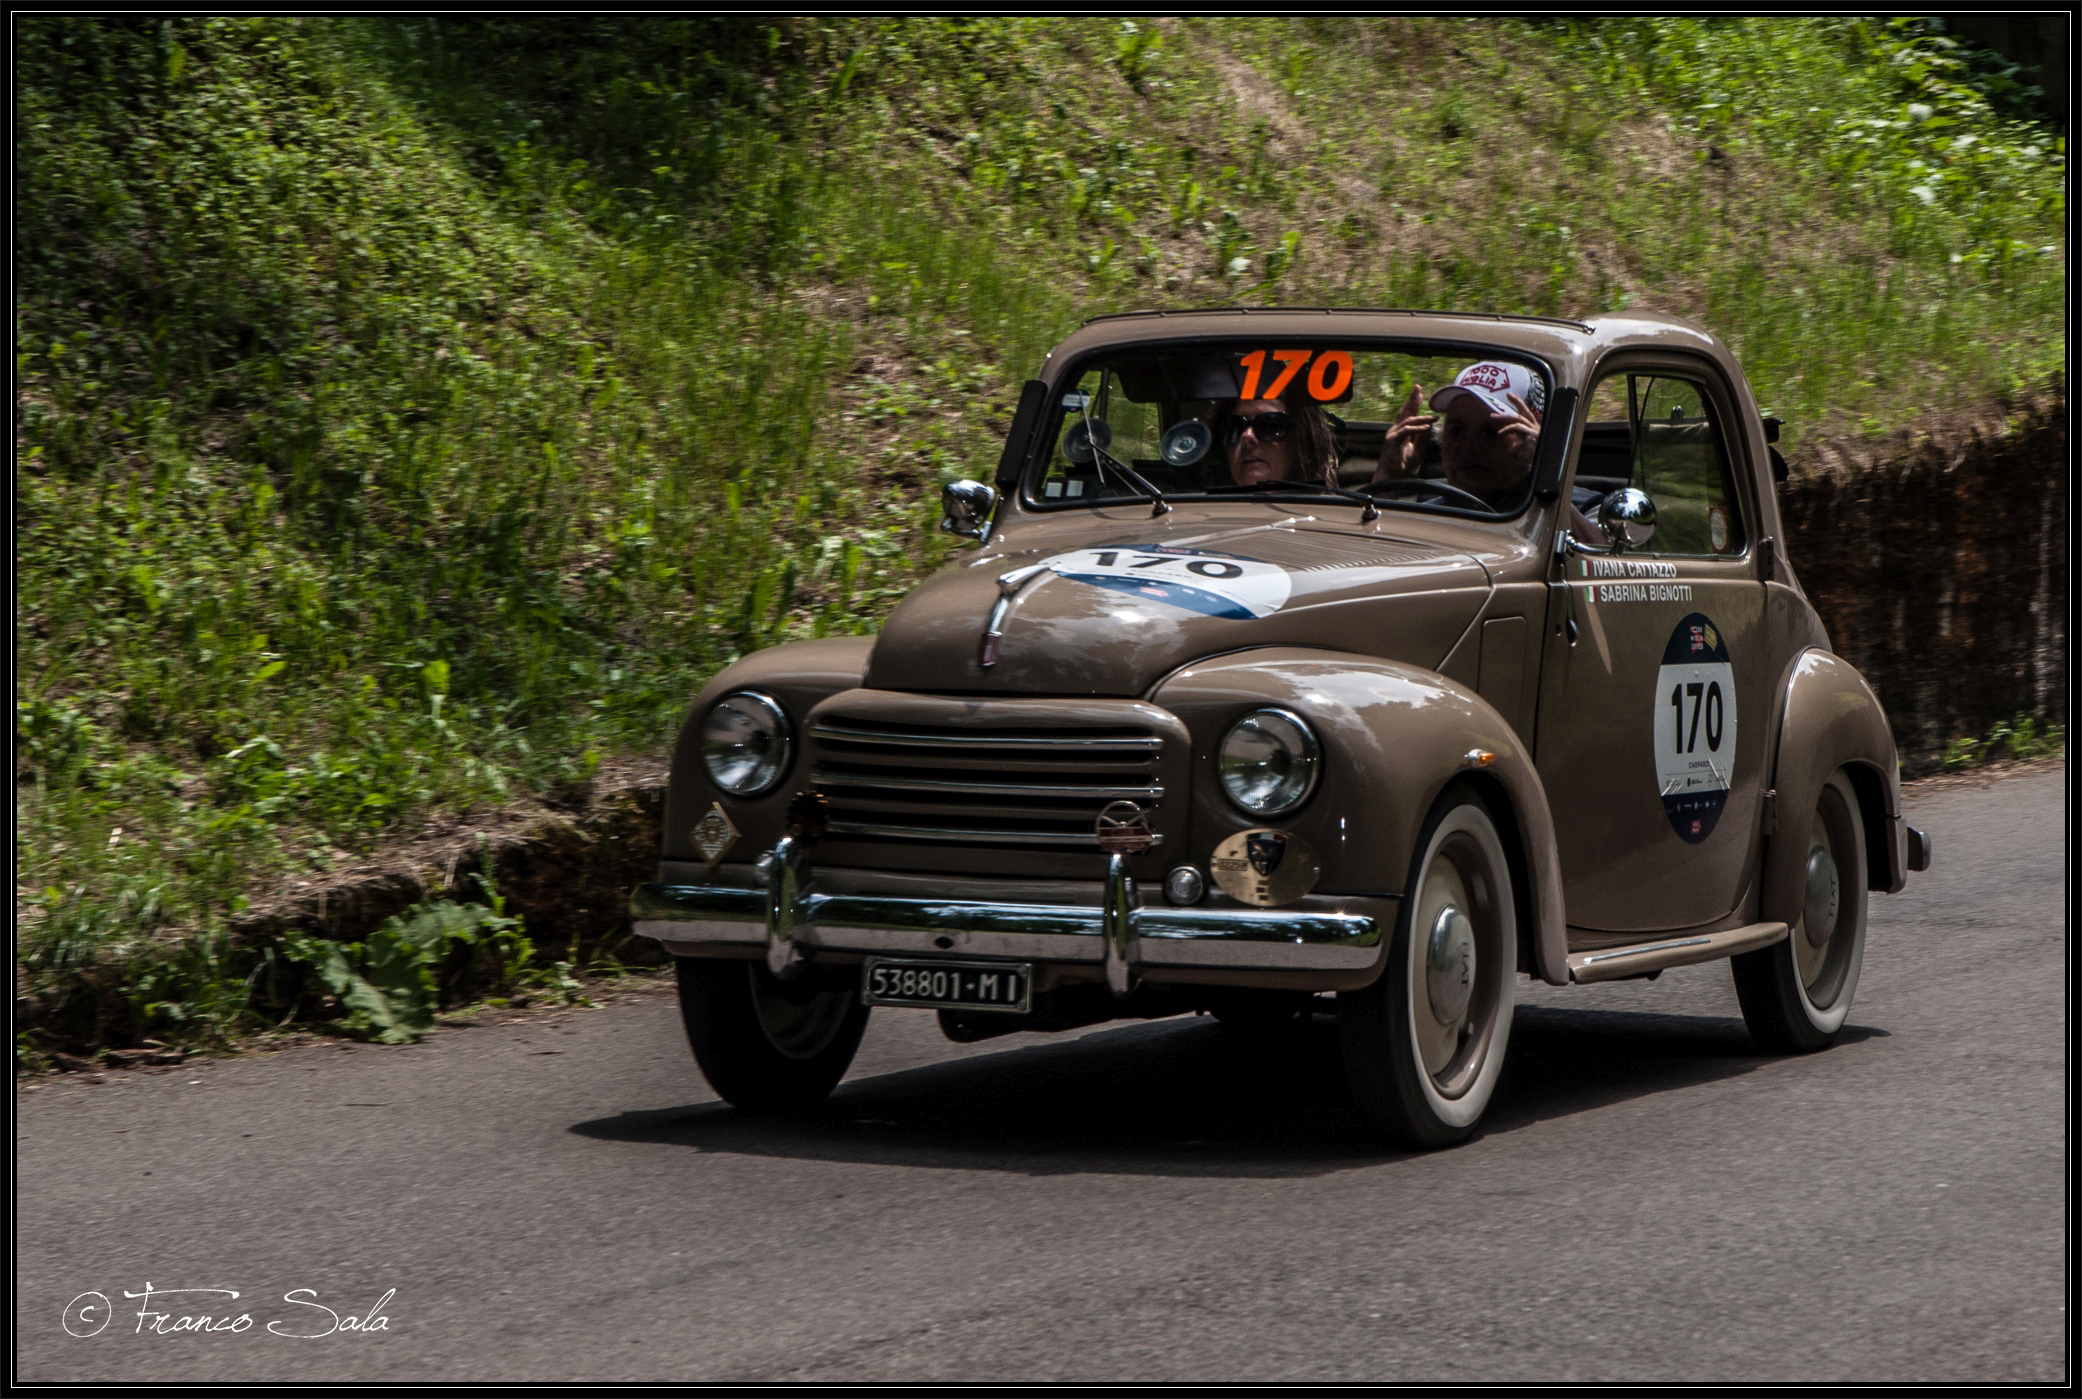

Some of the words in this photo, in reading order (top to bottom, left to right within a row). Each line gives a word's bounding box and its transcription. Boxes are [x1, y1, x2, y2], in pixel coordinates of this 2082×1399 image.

[1240, 350, 1353, 401] 170
[1469, 366, 1499, 376] 1000
[1089, 551, 1243, 579] 170
[1593, 561, 1626, 577] IVANA
[1626, 562, 1677, 578] CATTAZZO
[1600, 585, 1648, 602] SABRINA
[1649, 585, 1692, 602] BIGNOTTI
[1671, 681, 1723, 754] 170
